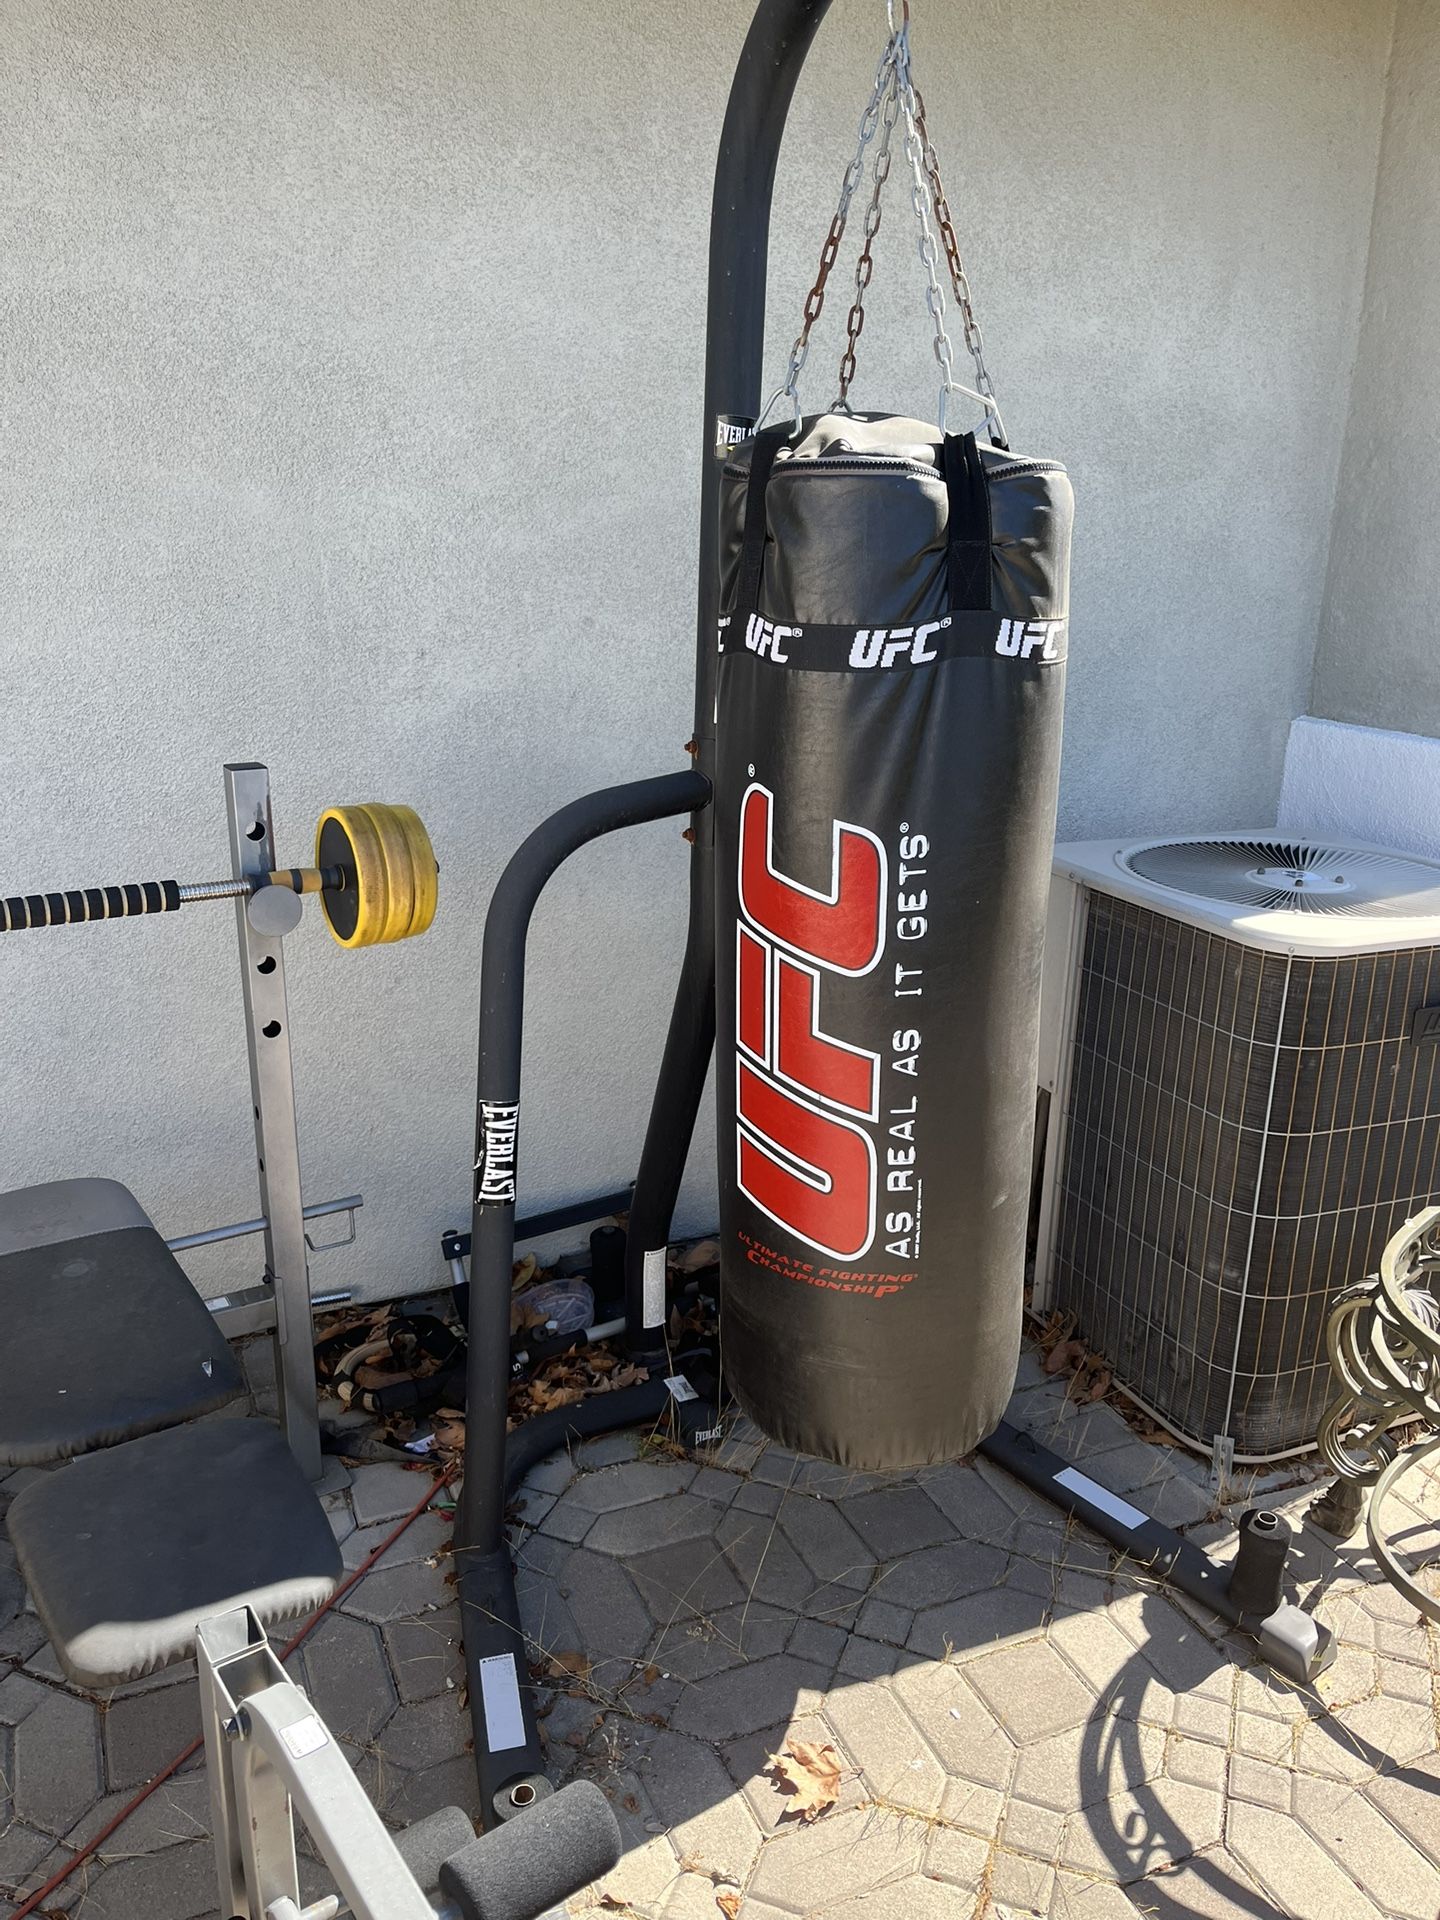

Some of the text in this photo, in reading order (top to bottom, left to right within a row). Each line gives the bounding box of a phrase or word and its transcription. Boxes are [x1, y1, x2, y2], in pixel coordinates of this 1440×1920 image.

[995, 618, 1065, 660] UFC
[895, 963, 923, 997] IT
[892, 1029, 921, 1076] AS
[478, 1103, 519, 1202] EVERLAST
[887, 1096, 917, 1191] REAL
[737, 1231, 815, 1272] ULTIMATE
[885, 1211, 914, 1258] AS
[695, 1425, 722, 1446] EVERLAST
